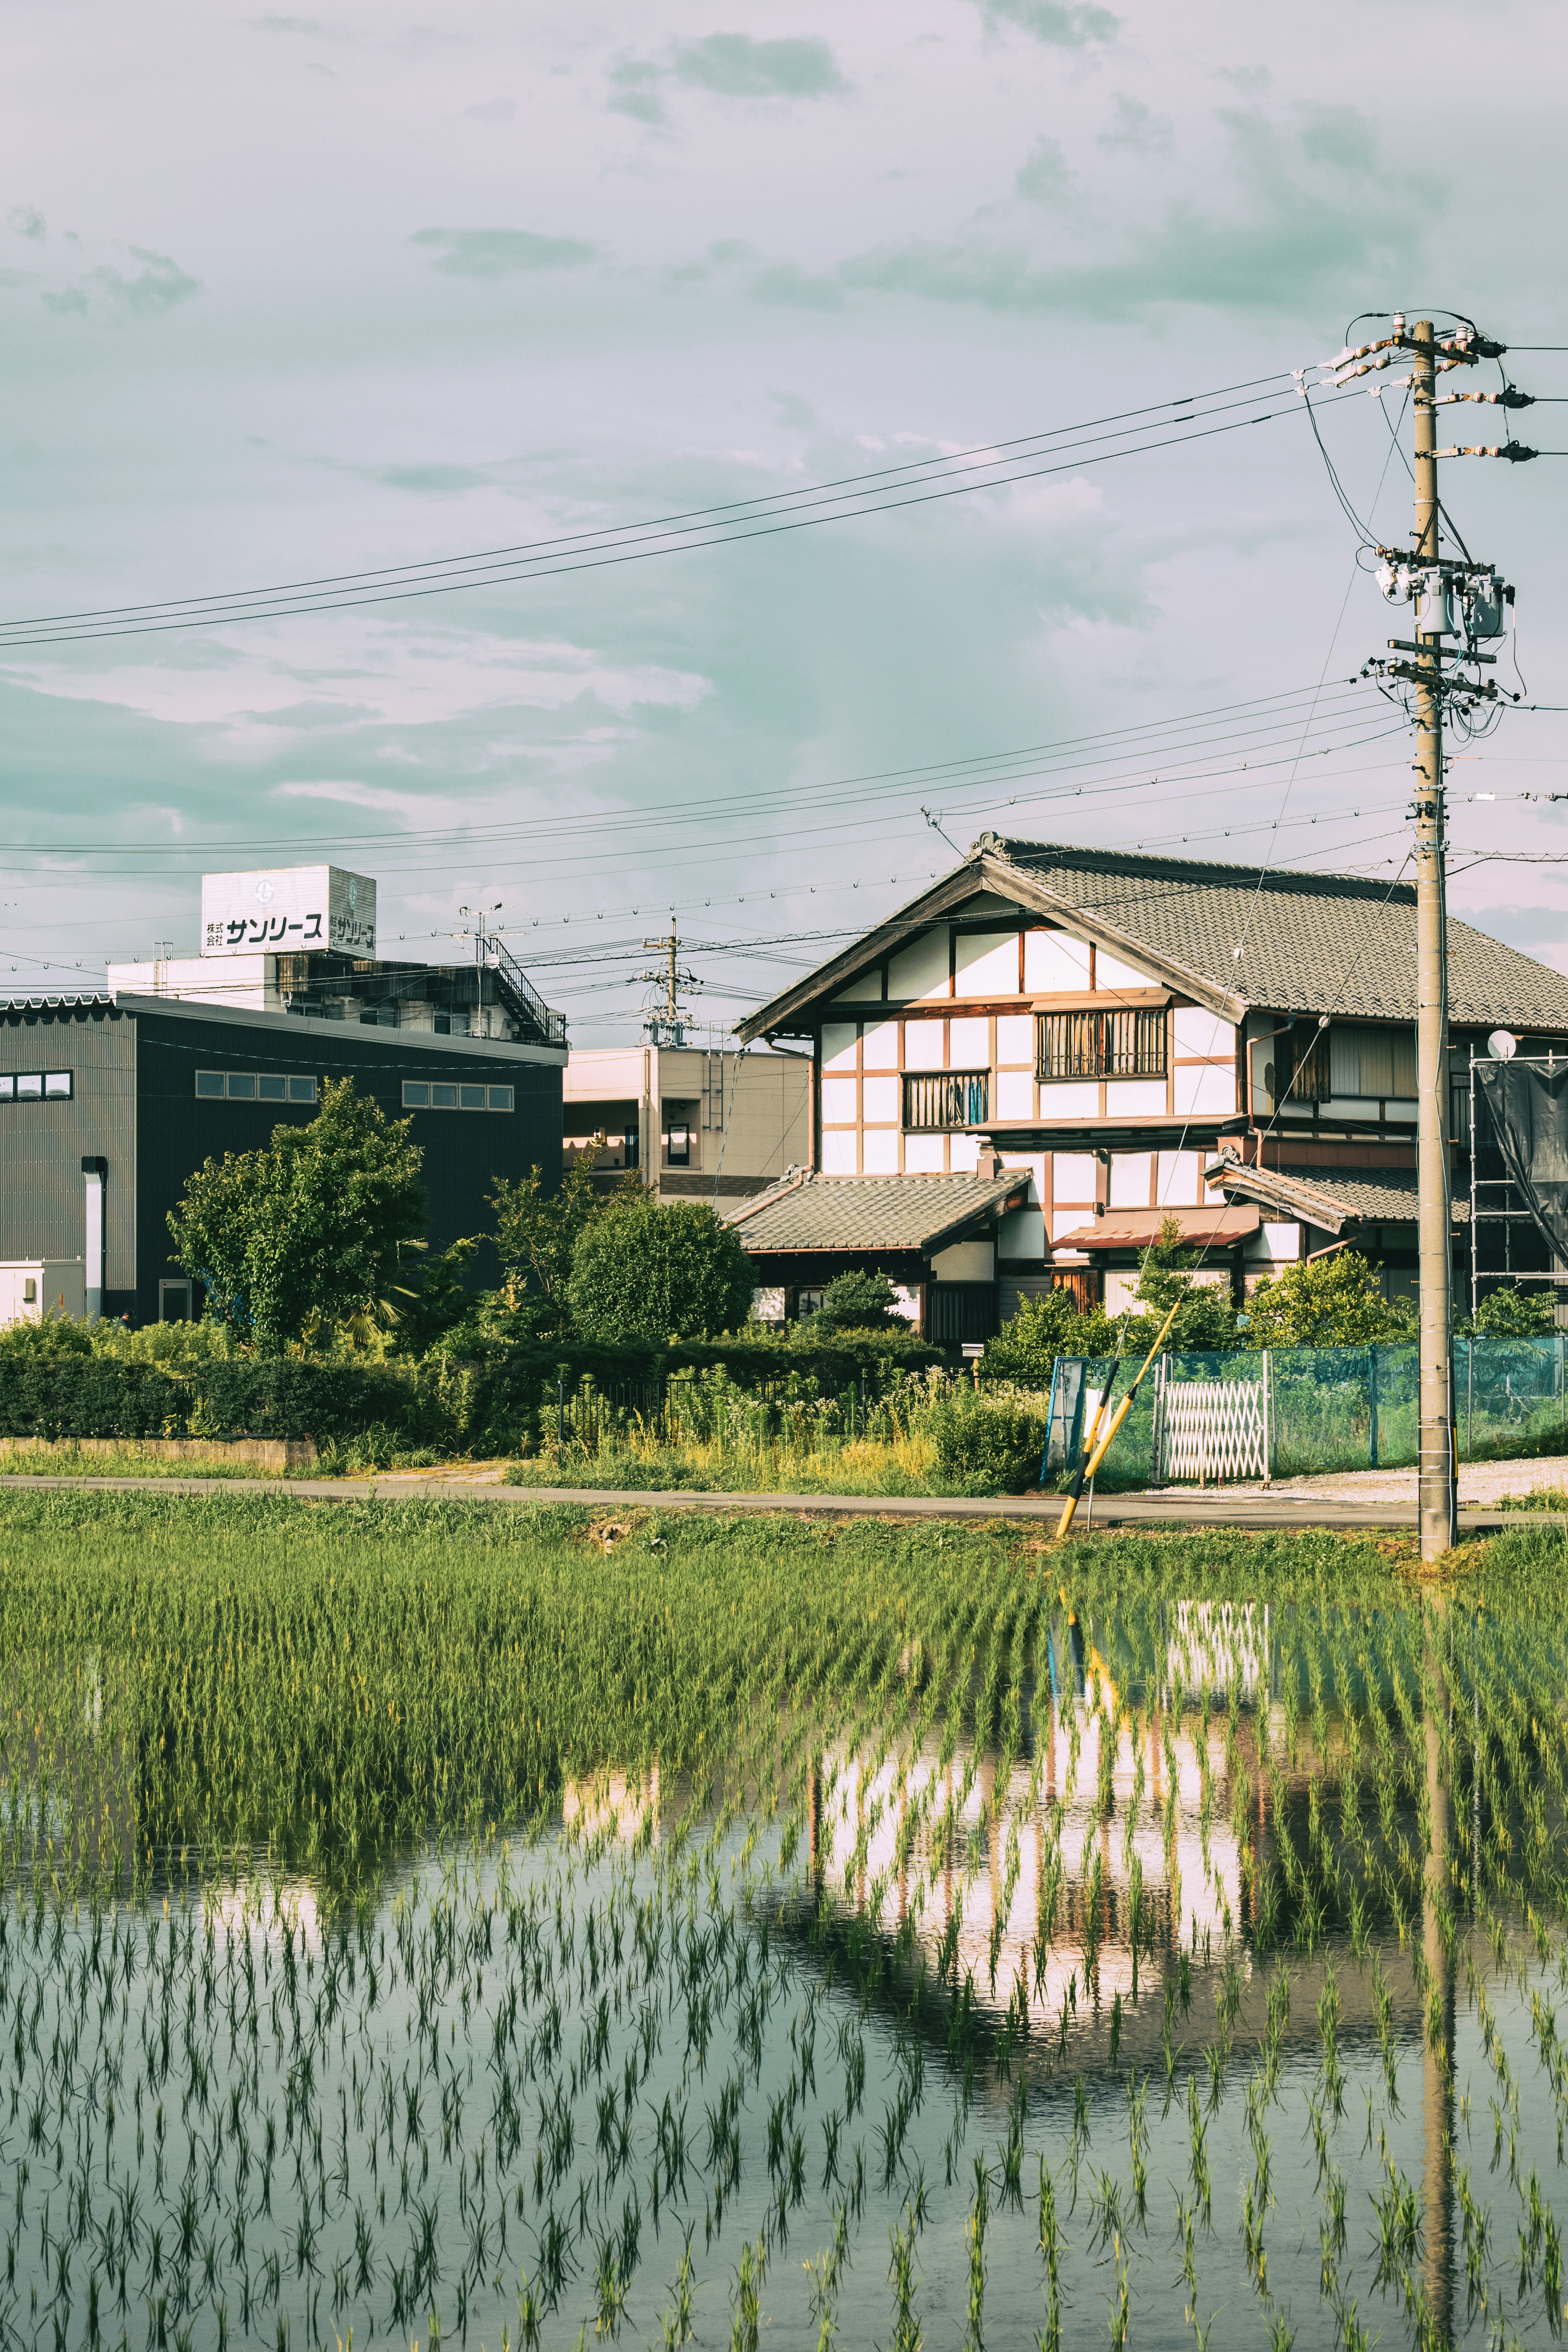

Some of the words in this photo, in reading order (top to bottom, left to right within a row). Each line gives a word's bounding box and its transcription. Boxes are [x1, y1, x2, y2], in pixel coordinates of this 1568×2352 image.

[207, 922, 223, 934] 株式
[227, 913, 323, 944] サンリース
[207, 935, 223, 946] 会社
